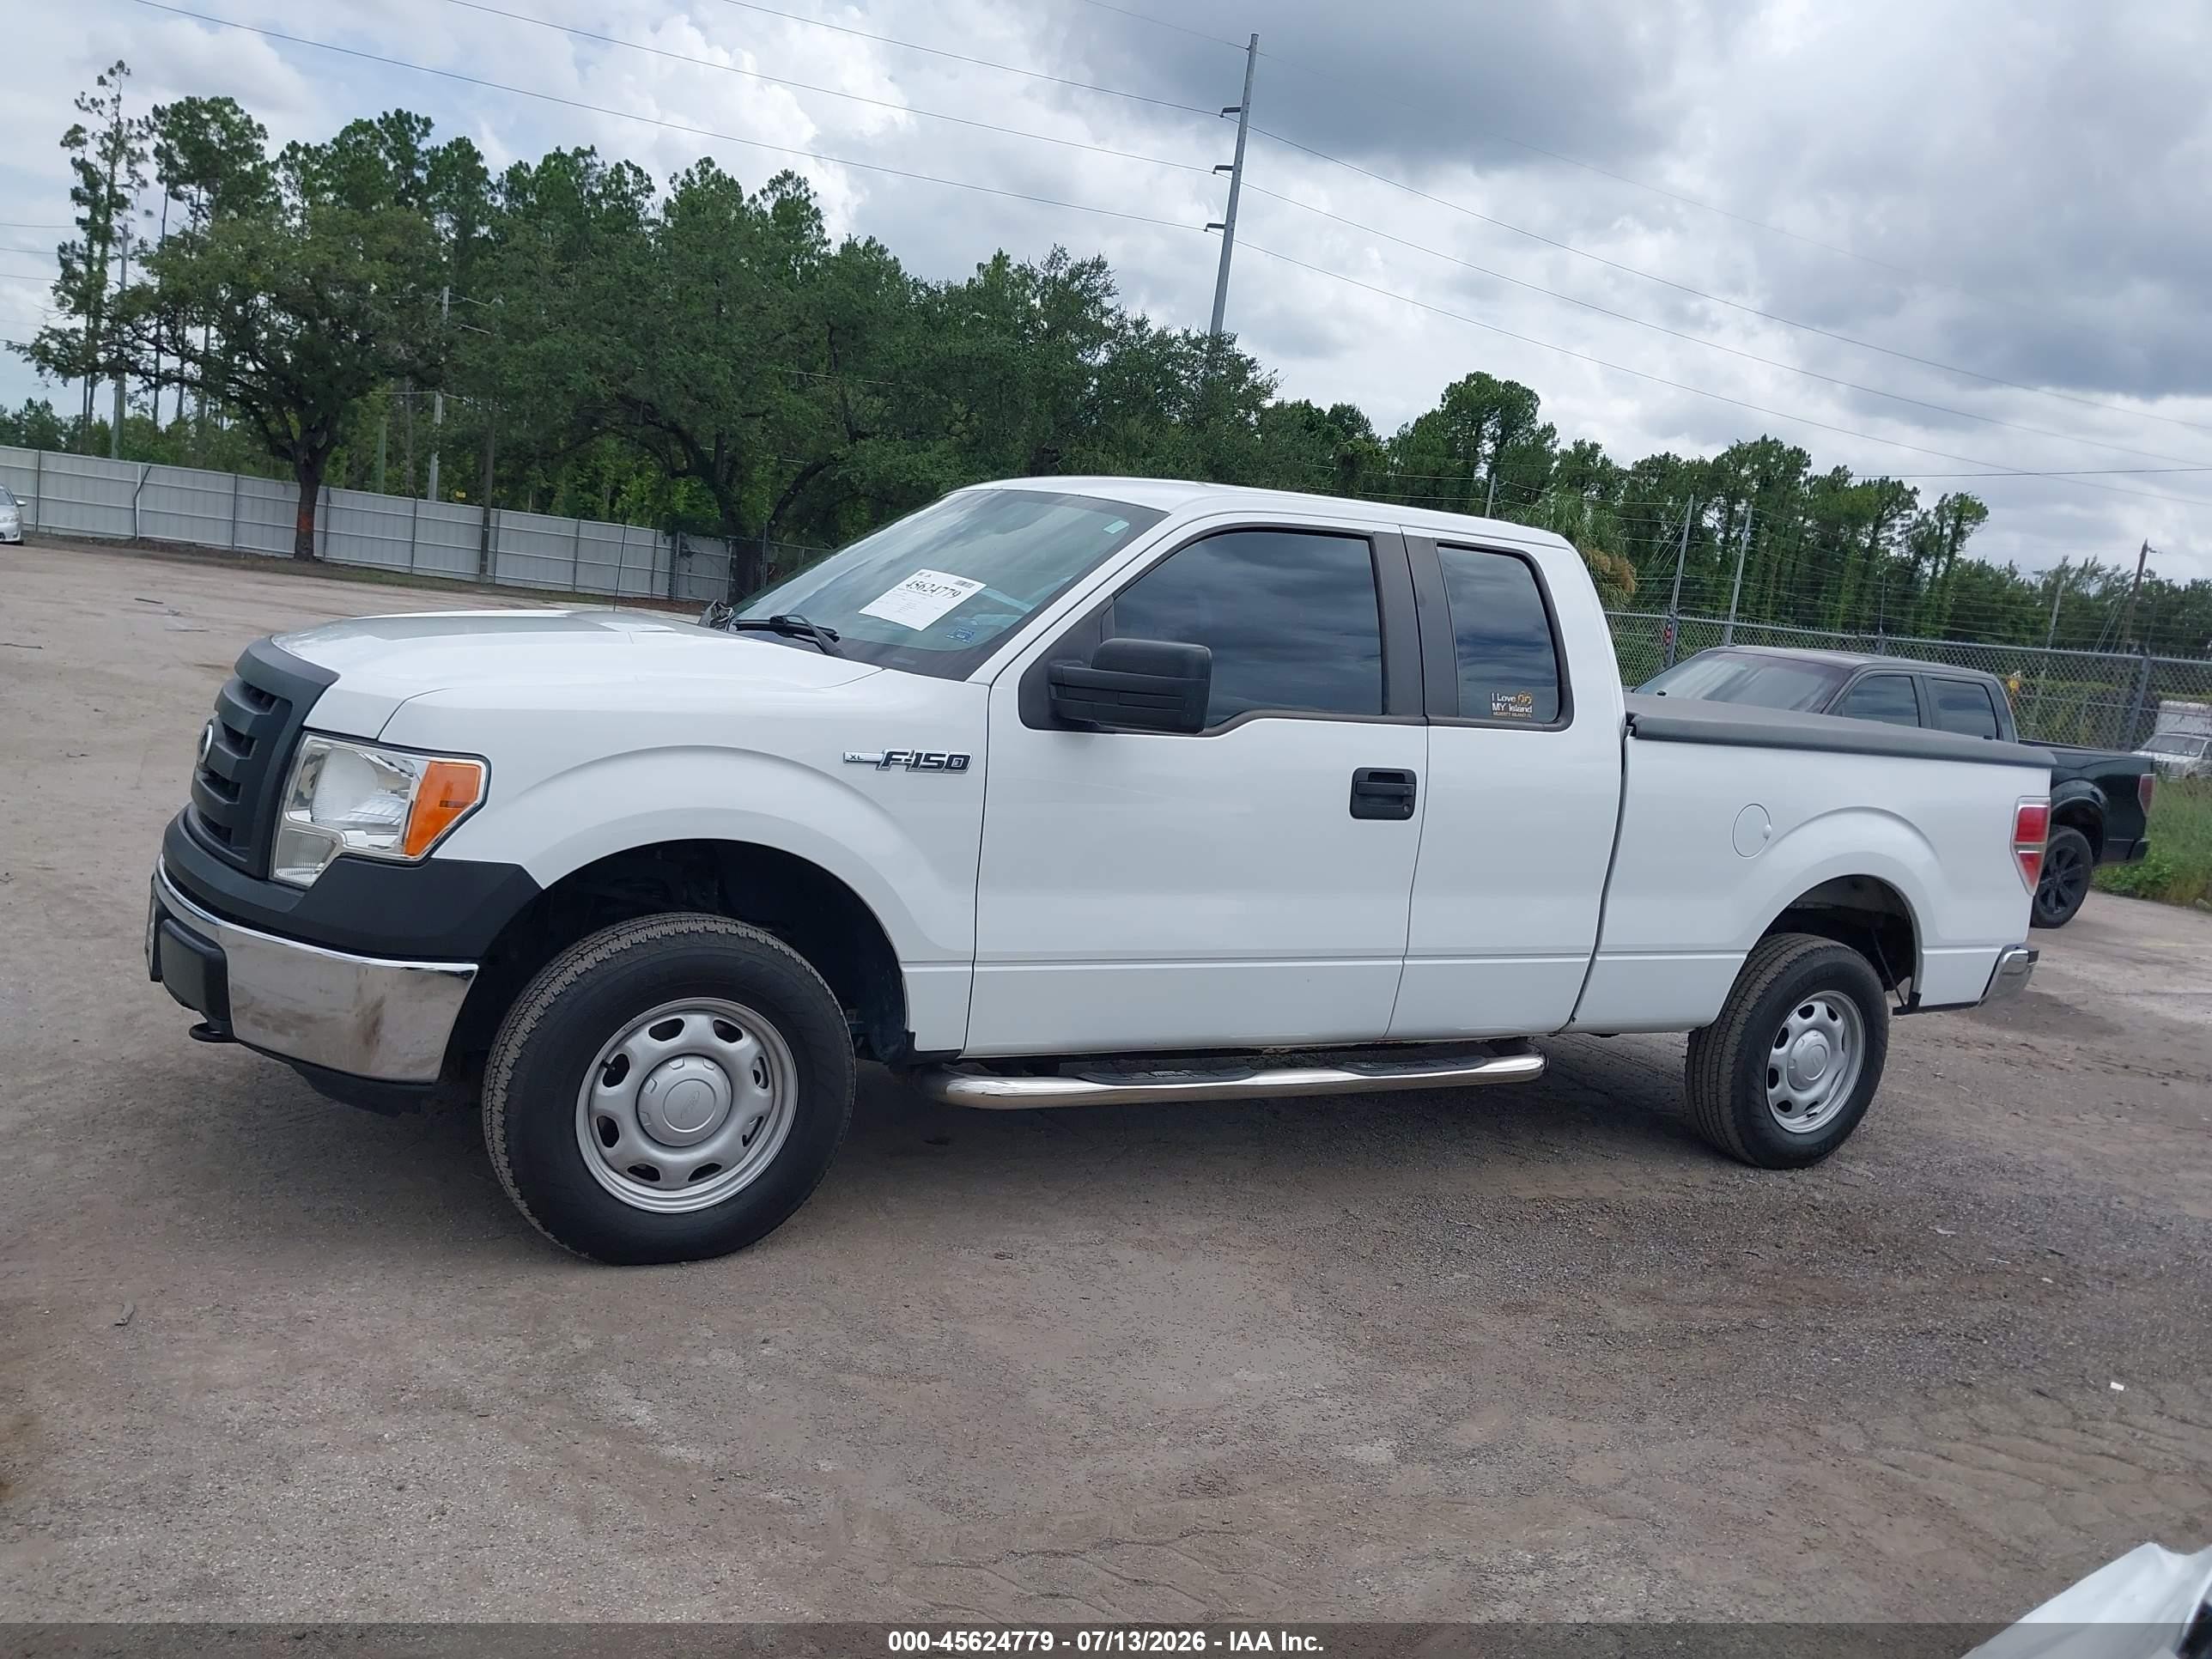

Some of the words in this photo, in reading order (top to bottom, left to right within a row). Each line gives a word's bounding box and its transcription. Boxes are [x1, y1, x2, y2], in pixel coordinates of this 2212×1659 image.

[906, 580, 962, 599] 45624779
[1497, 693, 1516, 702] Love
[1492, 702, 1507, 711] MY
[1509, 703, 1533, 714] Island
[877, 749, 973, 773] F-150
